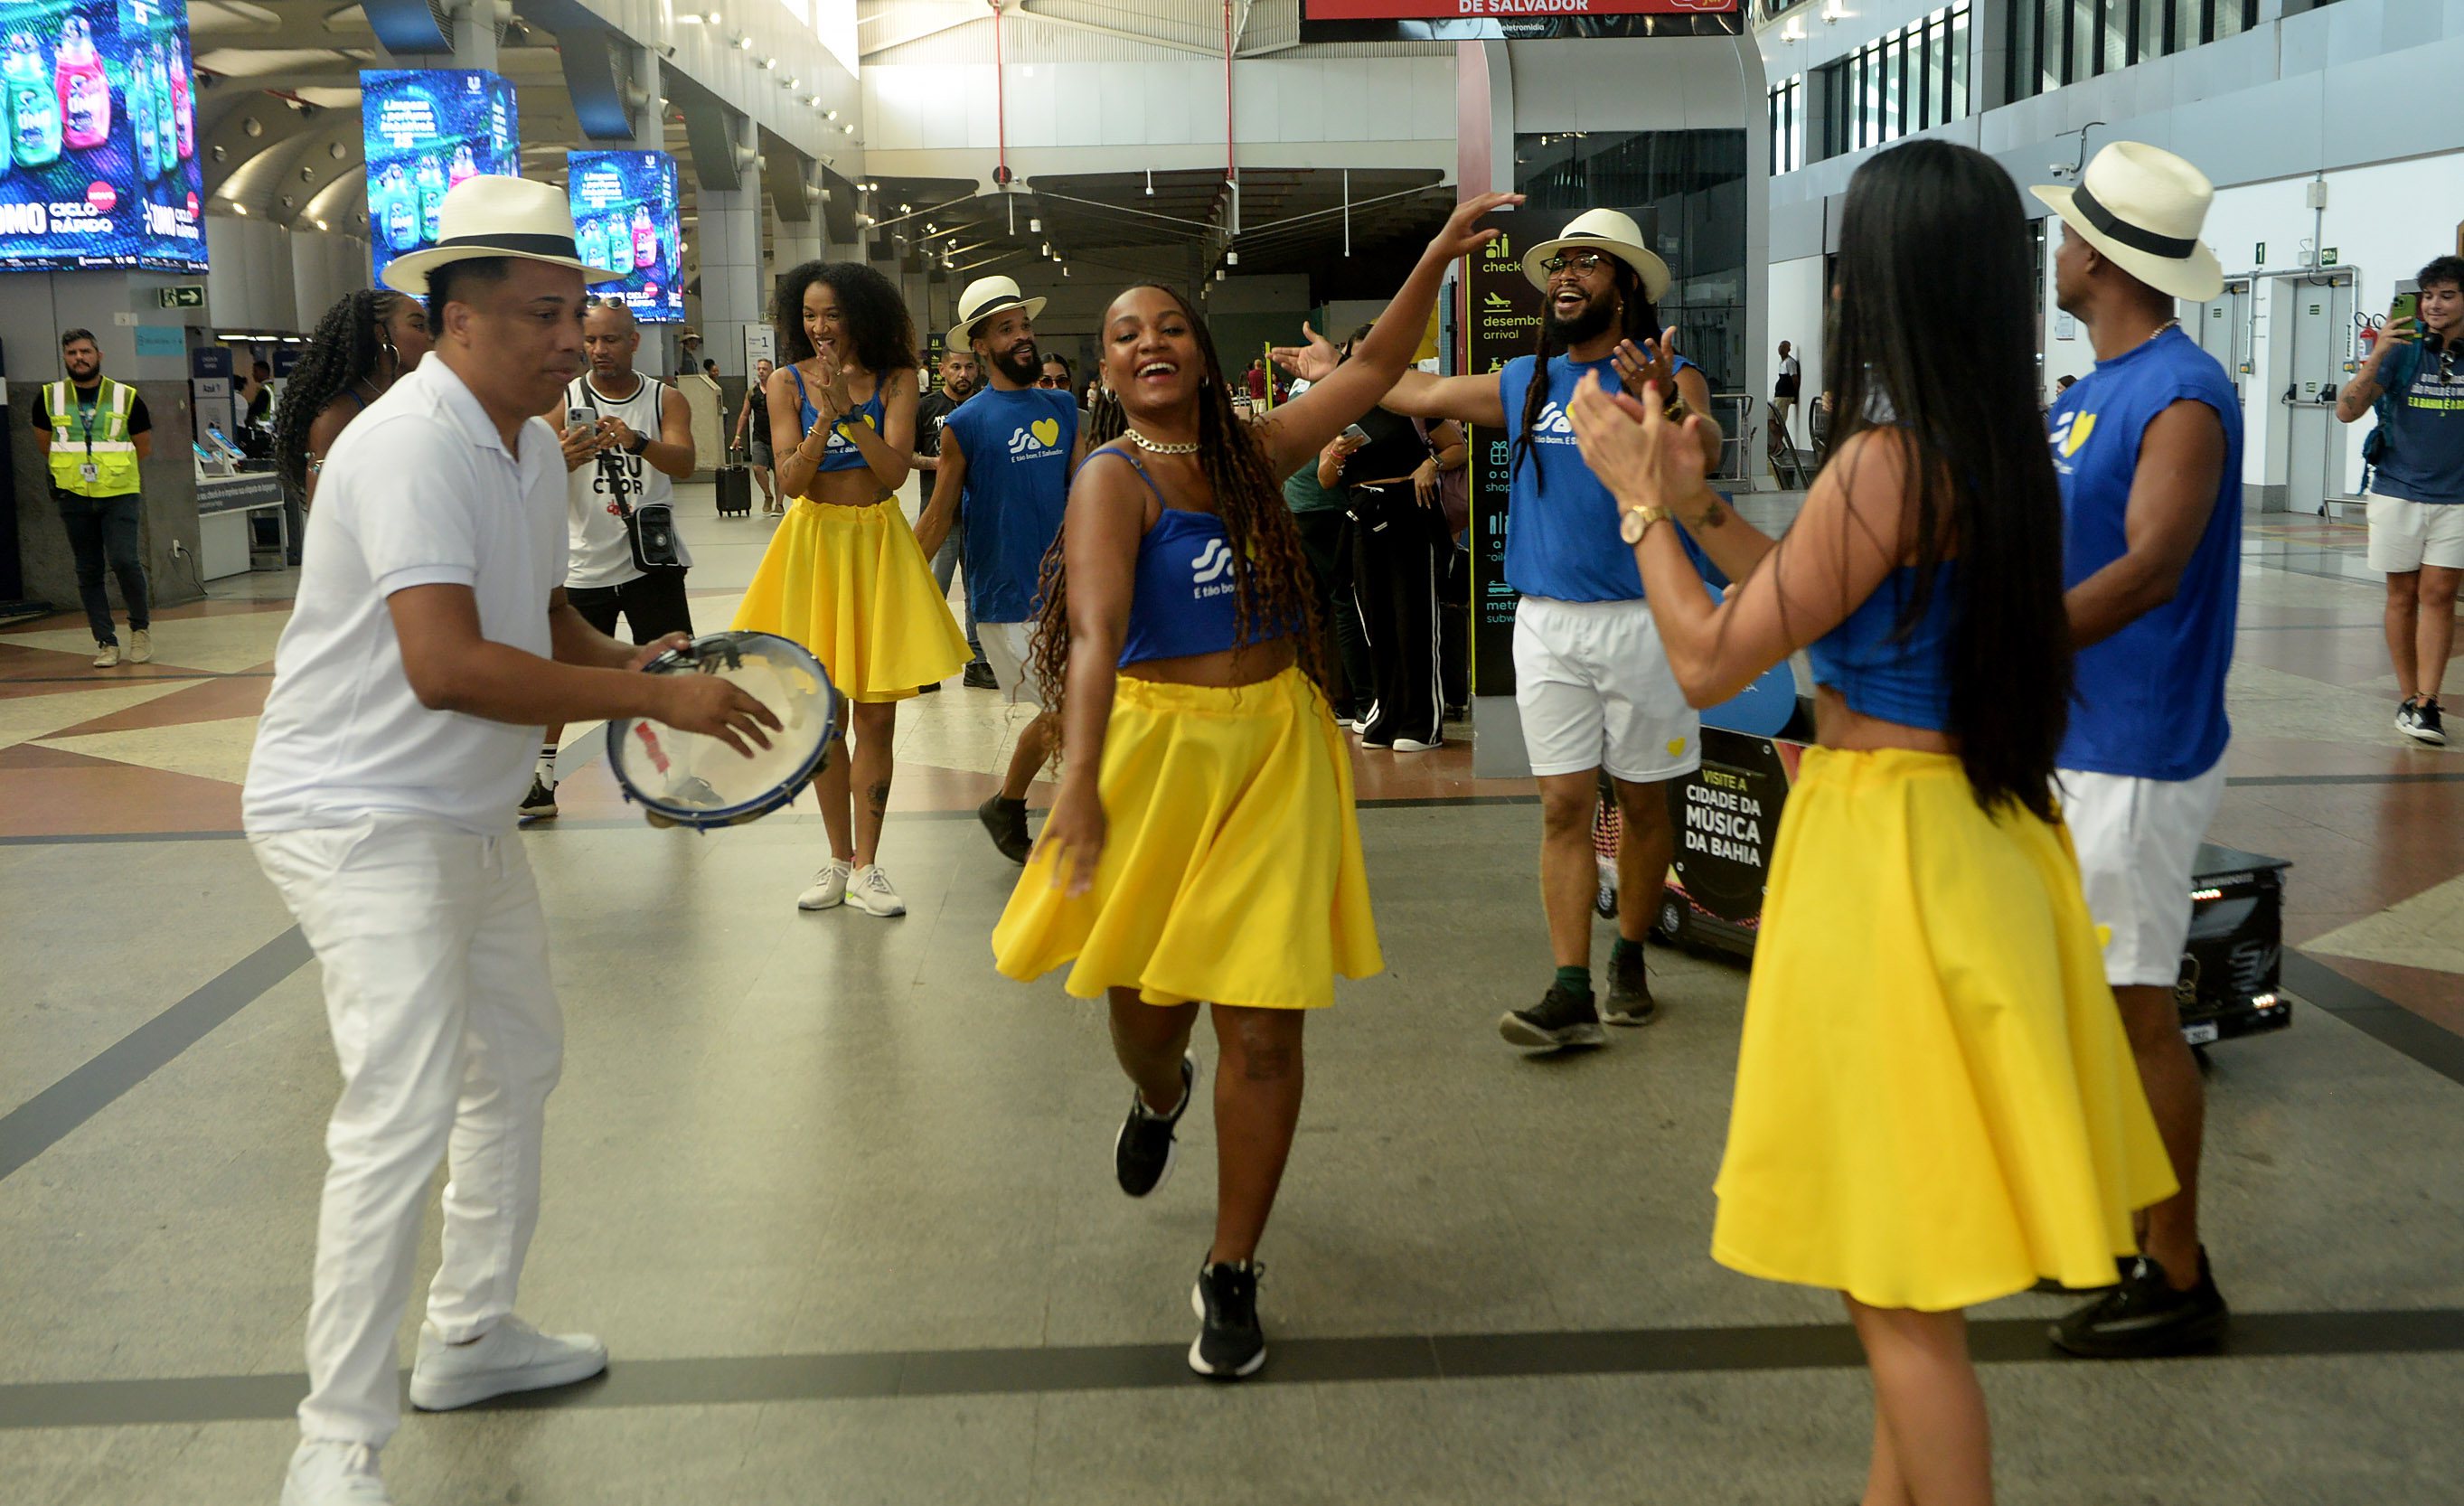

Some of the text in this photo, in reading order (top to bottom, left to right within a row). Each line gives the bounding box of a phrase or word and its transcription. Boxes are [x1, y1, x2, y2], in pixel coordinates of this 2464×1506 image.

[1459, 0, 1588, 13] DE SALVADOR
[49, 202, 99, 217] CICLO
[51, 215, 113, 233] RÁPIDO
[1483, 329, 1519, 340] arrival
[1221, 583, 1236, 594] bo
[1701, 769, 1747, 792] VISITE A
[1686, 785, 1762, 817] CIDADE DA
[1686, 804, 1762, 845] MÚSICA
[1686, 831, 1762, 867] DA BAHIA
